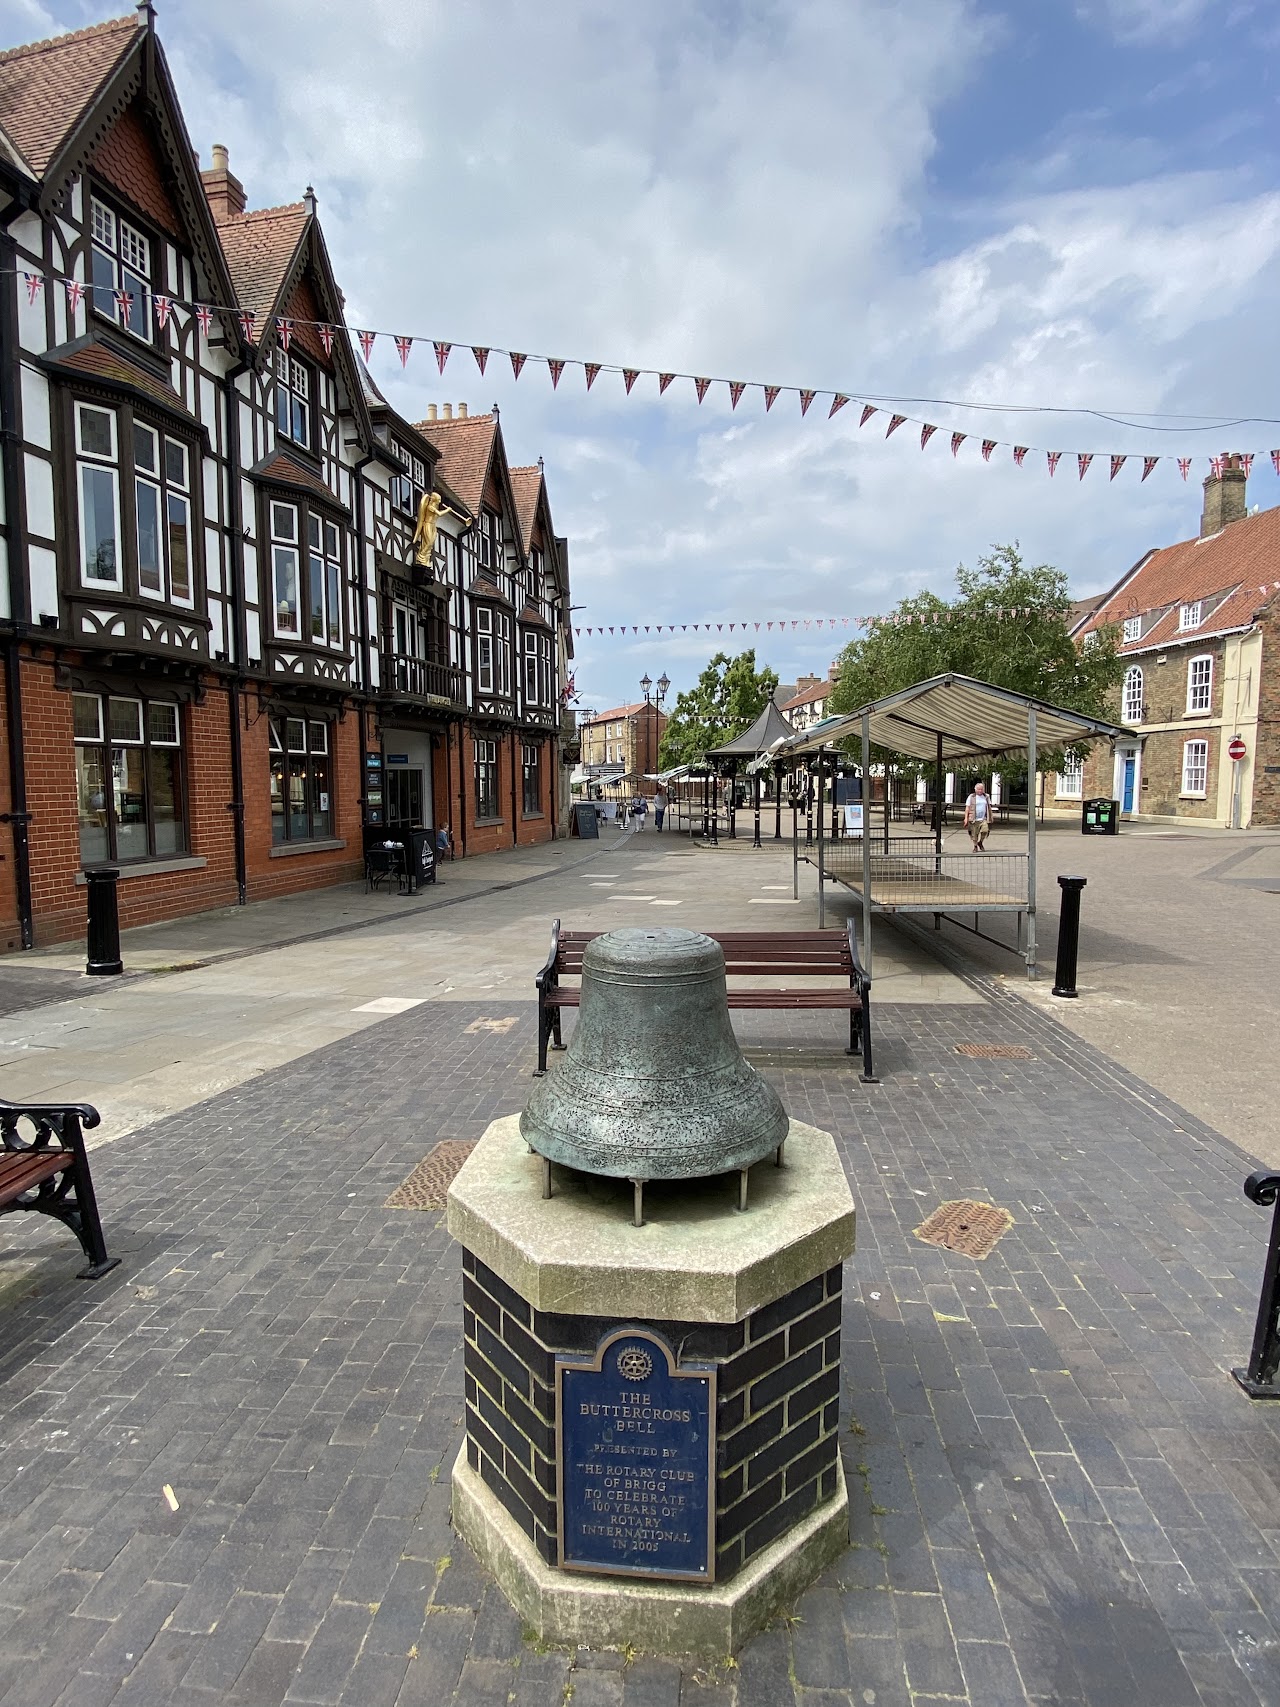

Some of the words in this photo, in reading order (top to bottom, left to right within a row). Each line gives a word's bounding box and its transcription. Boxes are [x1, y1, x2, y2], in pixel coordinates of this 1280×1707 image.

[620, 1392, 651, 1405] THE
[580, 1404, 691, 1422] BUTTERCROSS
[616, 1420, 655, 1434] BELL
[594, 1444, 658, 1456] PRESENTED
[662, 1448, 678, 1458] BY
[576, 1463, 603, 1475] THE
[606, 1466, 657, 1478] ROTARY
[660, 1469, 695, 1482] CLUB
[604, 1478, 620, 1488] OF
[625, 1479, 667, 1492] BRIGG
[585, 1488, 602, 1499] TO
[607, 1490, 686, 1506] CELEBRATE
[592, 1501, 610, 1512] 100
[614, 1503, 657, 1516] YEARS
[661, 1507, 678, 1518] OF
[610, 1515, 662, 1528] ROTARY
[582, 1524, 691, 1543] INTERNATIONAL
[612, 1540, 627, 1549] IN
[631, 1541, 659, 1552] 2005
